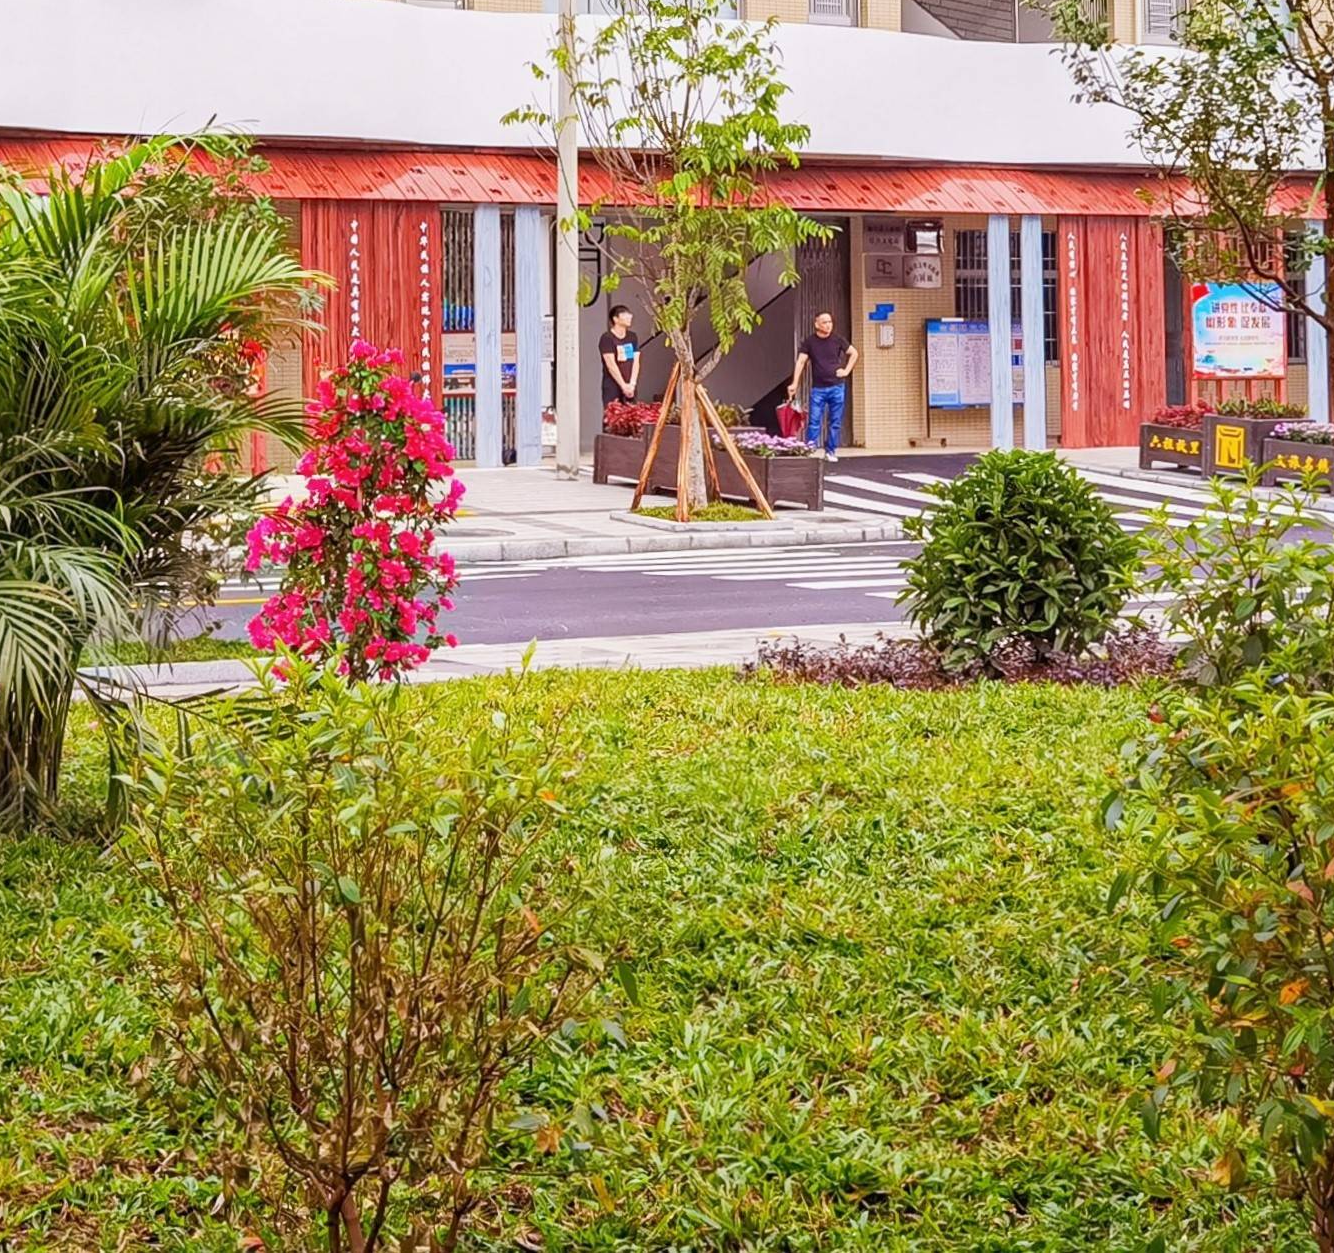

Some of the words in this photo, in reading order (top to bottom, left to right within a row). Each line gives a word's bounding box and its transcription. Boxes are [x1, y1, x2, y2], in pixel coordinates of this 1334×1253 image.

[1149, 435, 1200, 455] 六祖故里
[1274, 454, 1330, 474] 文旅名镇
